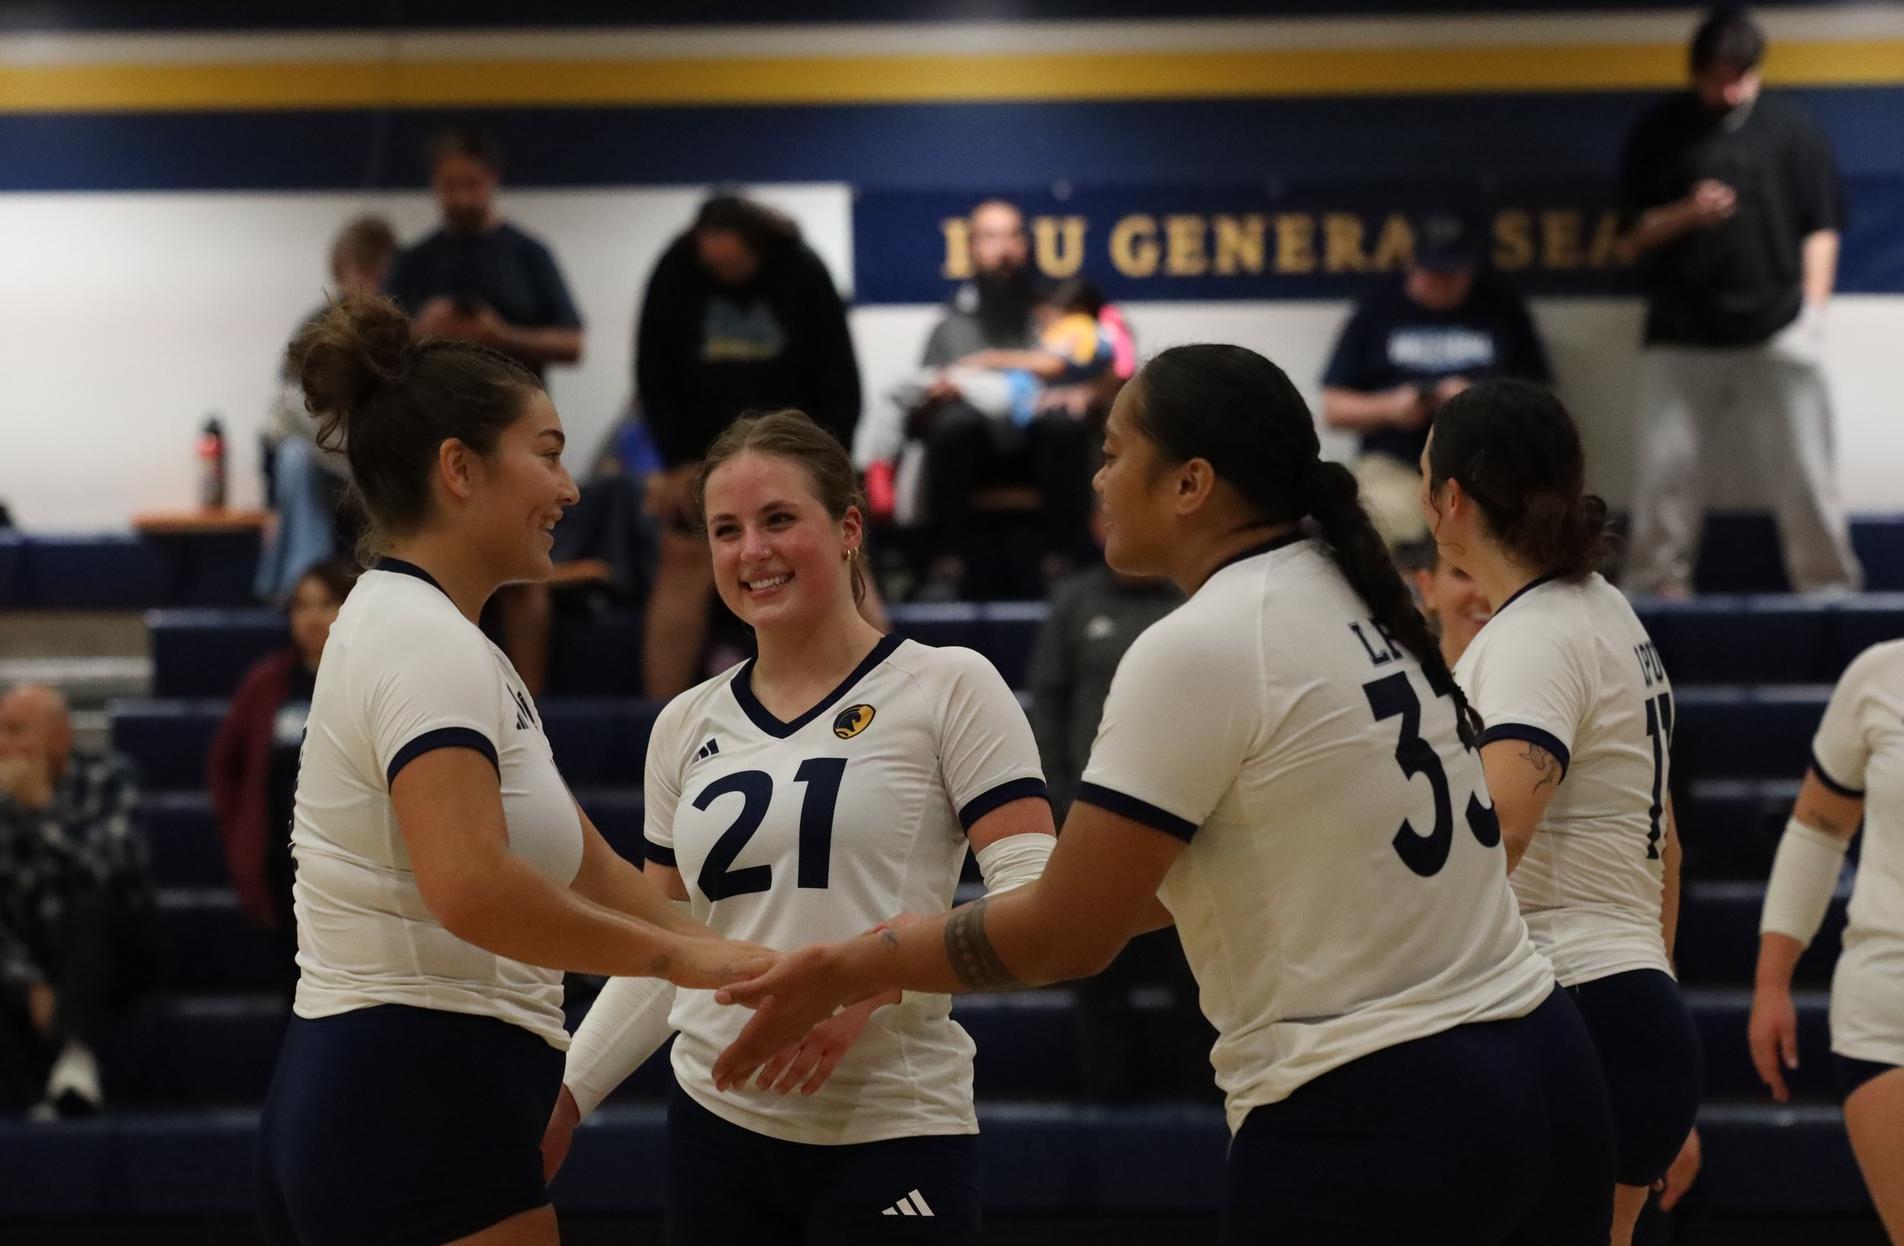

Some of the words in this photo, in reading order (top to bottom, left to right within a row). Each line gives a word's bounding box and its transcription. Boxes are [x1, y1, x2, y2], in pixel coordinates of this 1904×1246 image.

[1107, 211, 1420, 279] GENERA
[1490, 208, 1639, 271] SEA
[692, 757, 848, 903] 21
